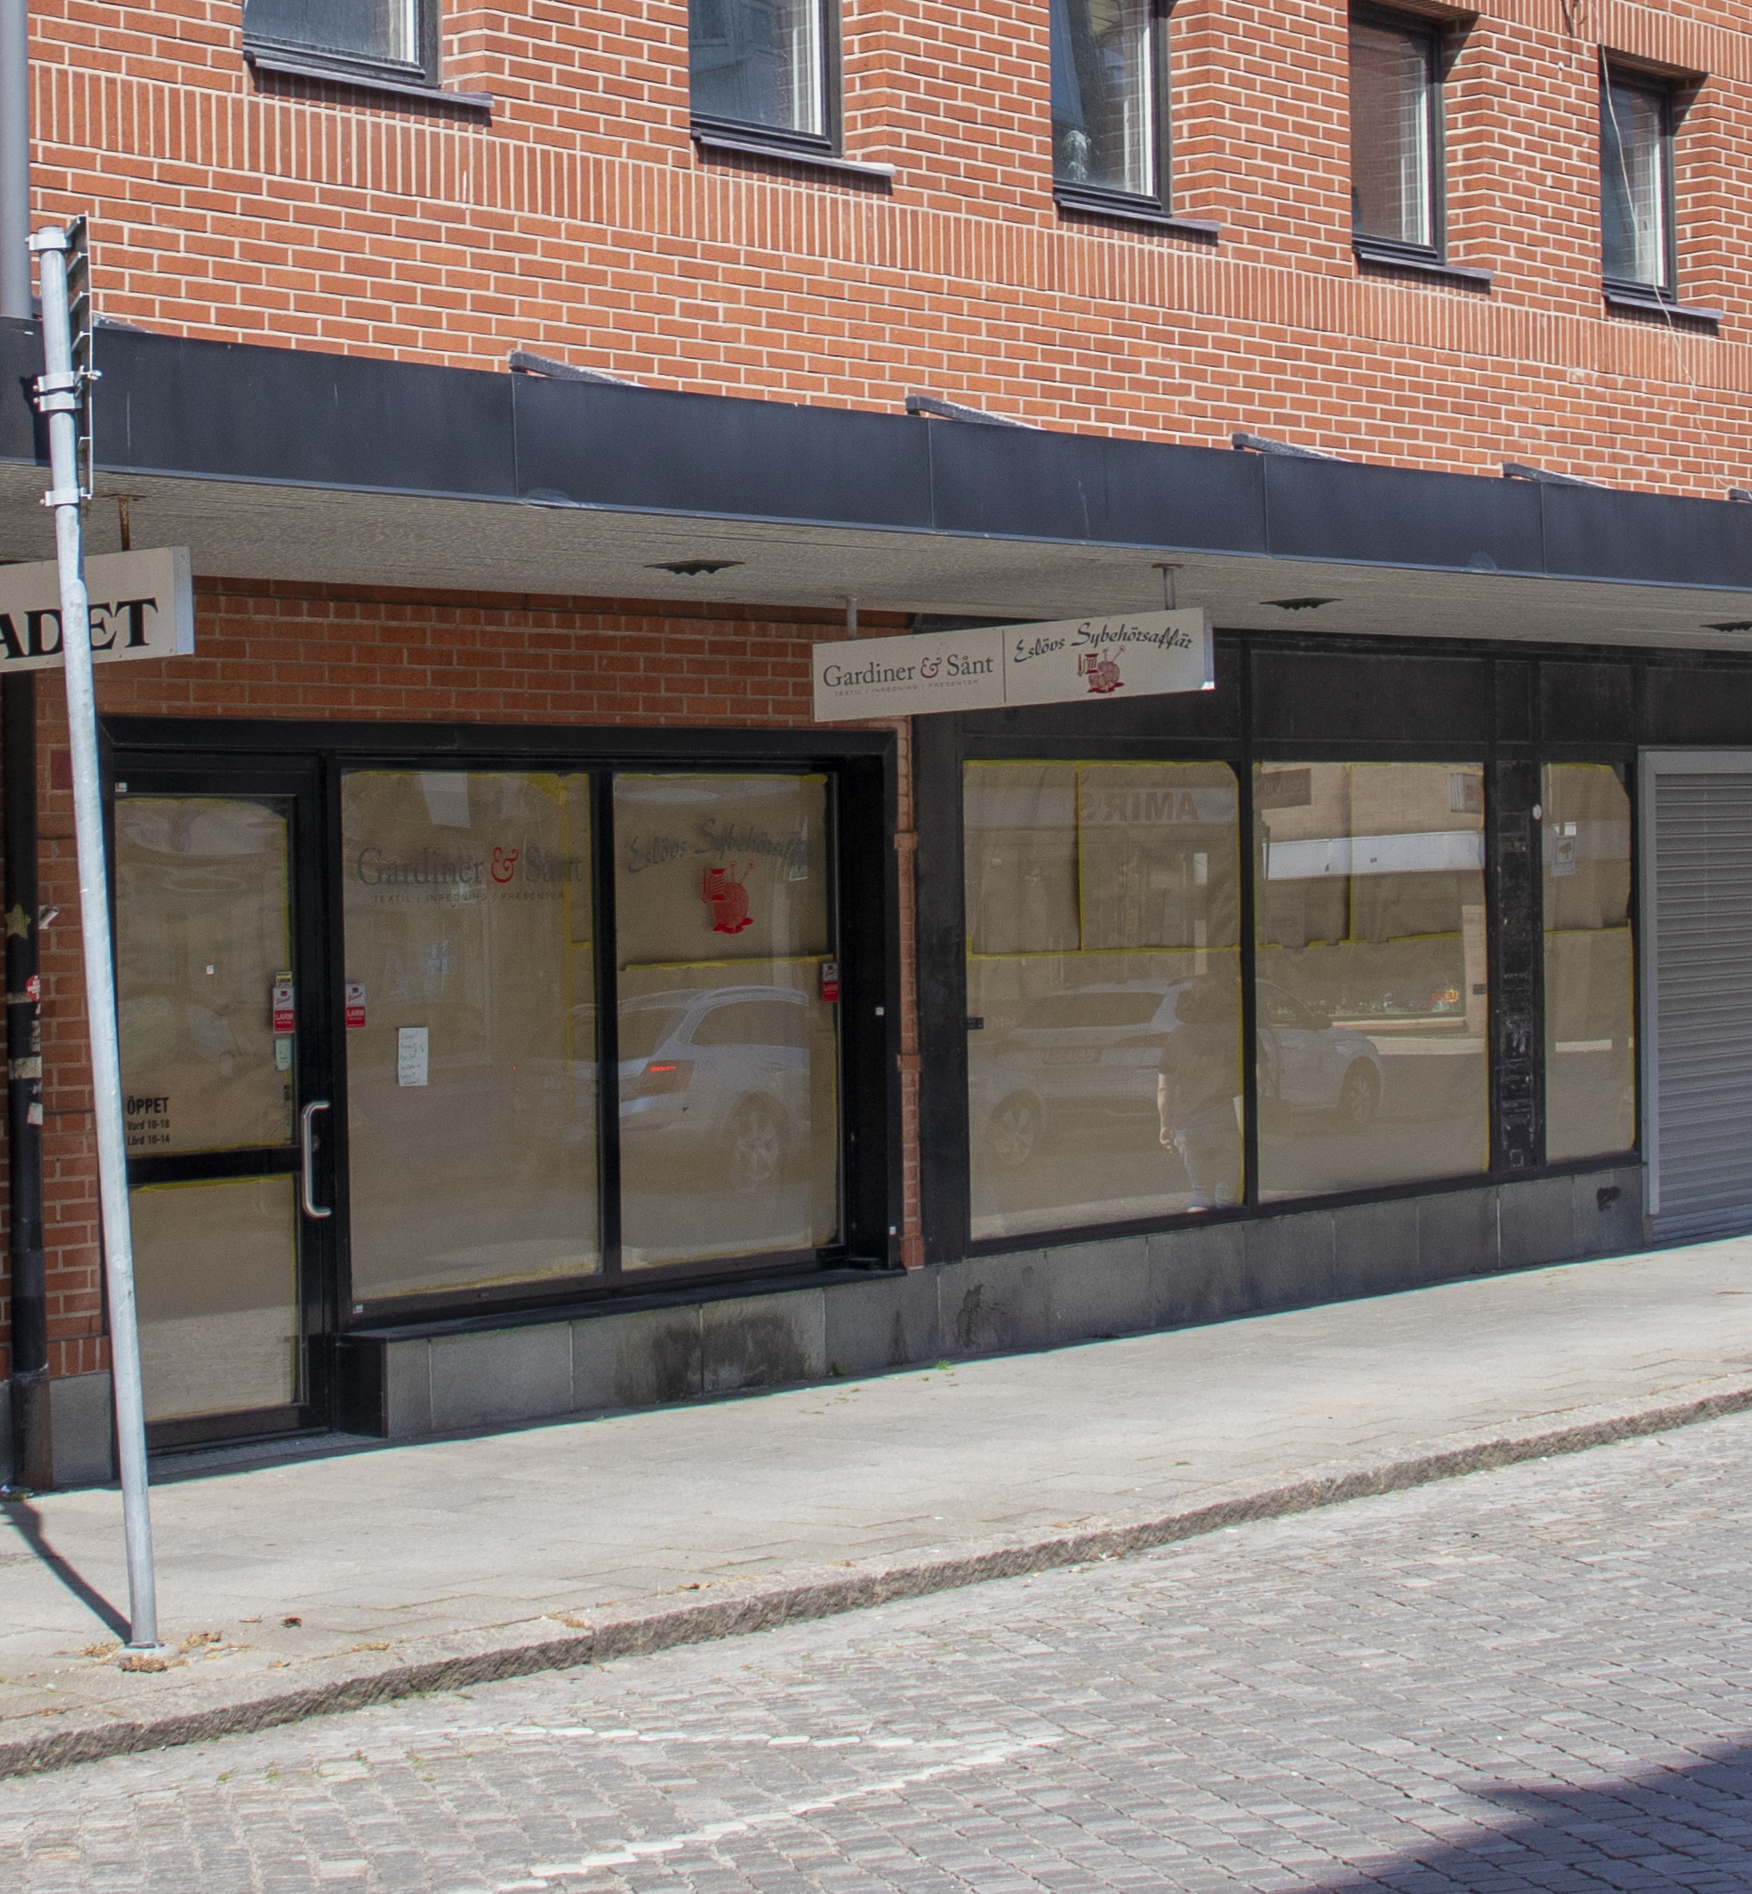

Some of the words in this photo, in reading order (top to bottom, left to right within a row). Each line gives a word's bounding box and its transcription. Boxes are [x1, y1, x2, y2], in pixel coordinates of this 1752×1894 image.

[1013, 637, 1066, 663] Eslövs
[1070, 621, 1194, 650] Sybehörsaffär
[822, 661, 917, 688] Gardiner
[920, 656, 943, 679] &
[946, 653, 995, 677] Sånt
[356, 846, 485, 886] Gardiner
[490, 846, 520, 884] &
[127, 1094, 170, 1116] ÖPPET
